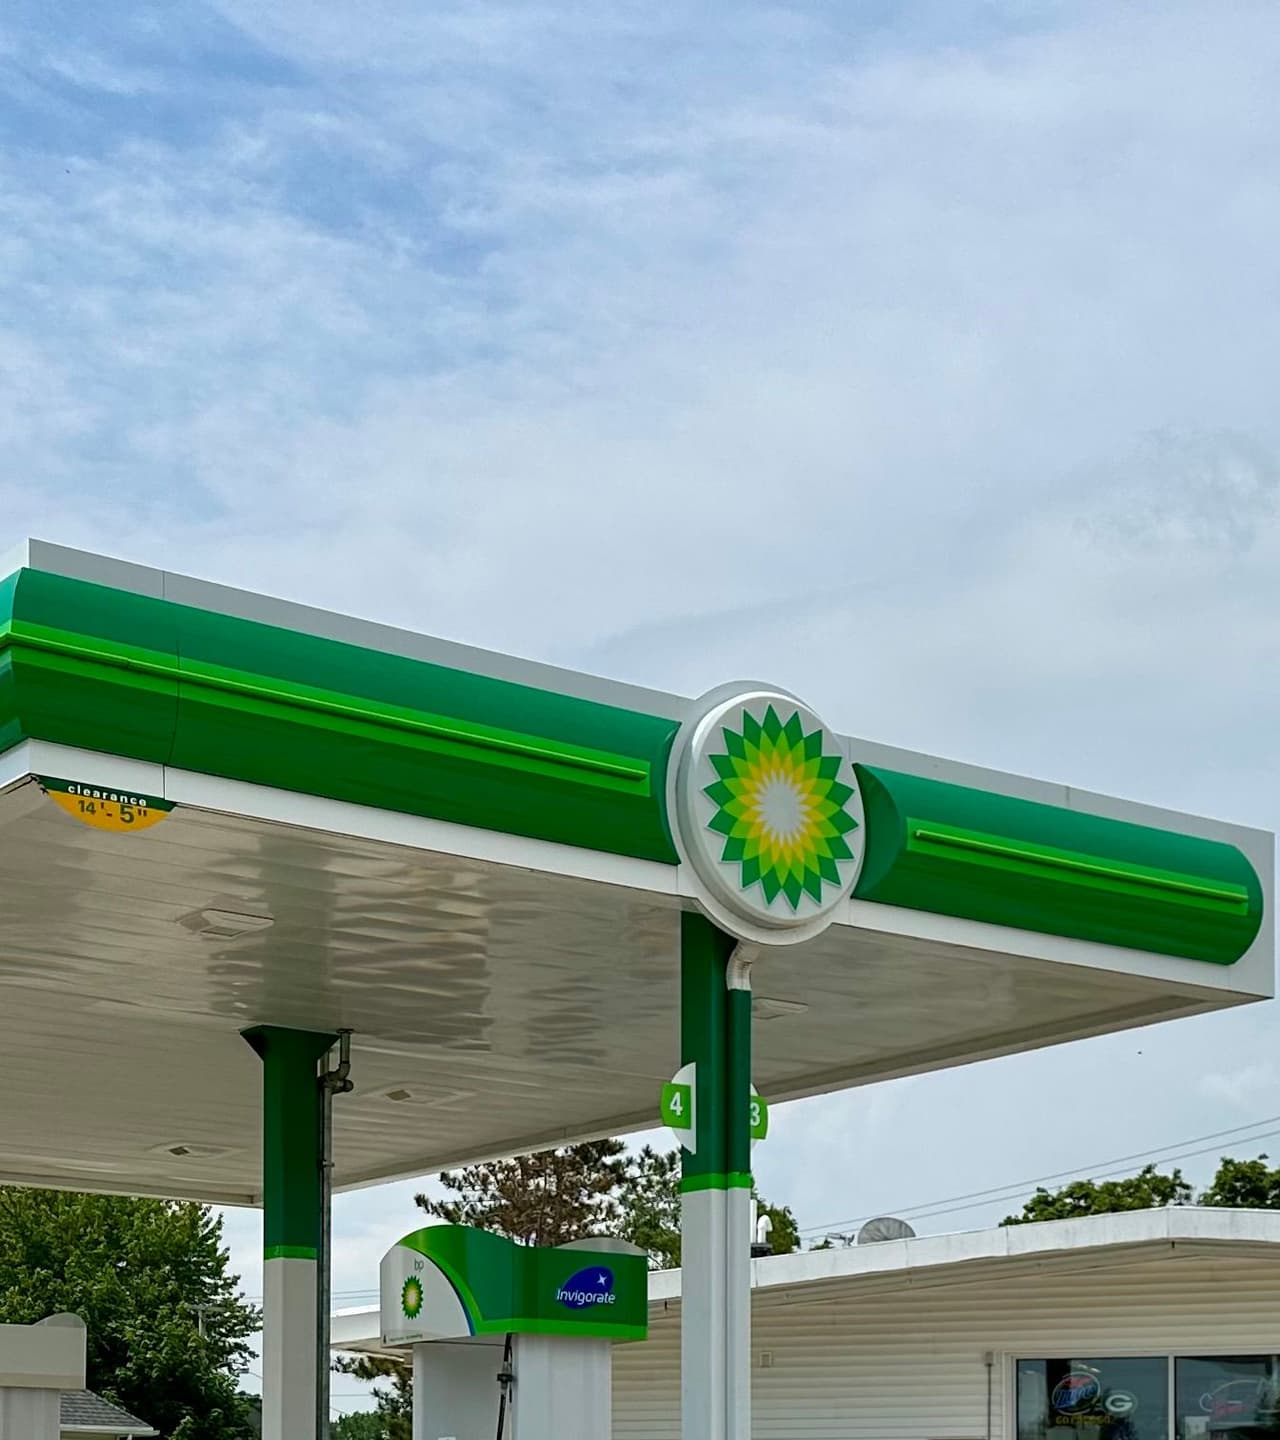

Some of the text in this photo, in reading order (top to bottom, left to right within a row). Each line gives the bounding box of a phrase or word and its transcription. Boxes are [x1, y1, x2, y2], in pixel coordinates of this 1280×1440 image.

[67, 785, 148, 808] clearance
[669, 1091, 683, 1117] 4
[750, 1102, 761, 1127] 3
[413, 1259, 425, 1272] bp
[556, 1288, 616, 1306] Invigorate
